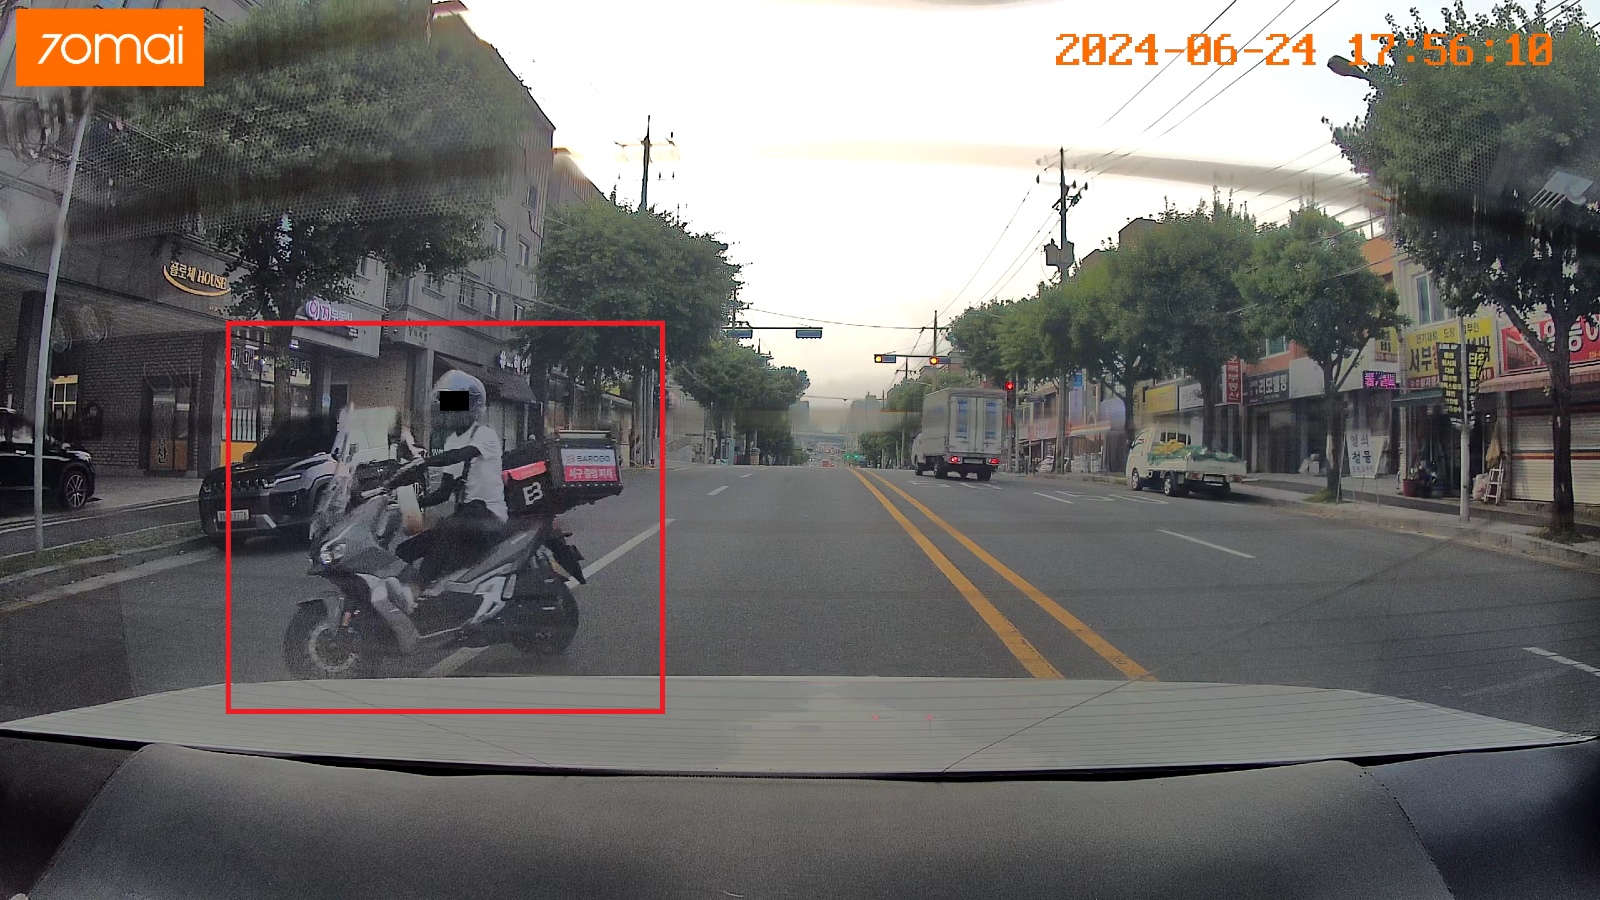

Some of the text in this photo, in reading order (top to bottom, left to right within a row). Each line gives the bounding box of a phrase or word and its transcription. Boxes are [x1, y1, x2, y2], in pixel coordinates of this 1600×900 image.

[197, 268, 227, 290] HOUSE
[576, 455, 611, 463] BAROGO
[1352, 450, 1372, 464] 철물
